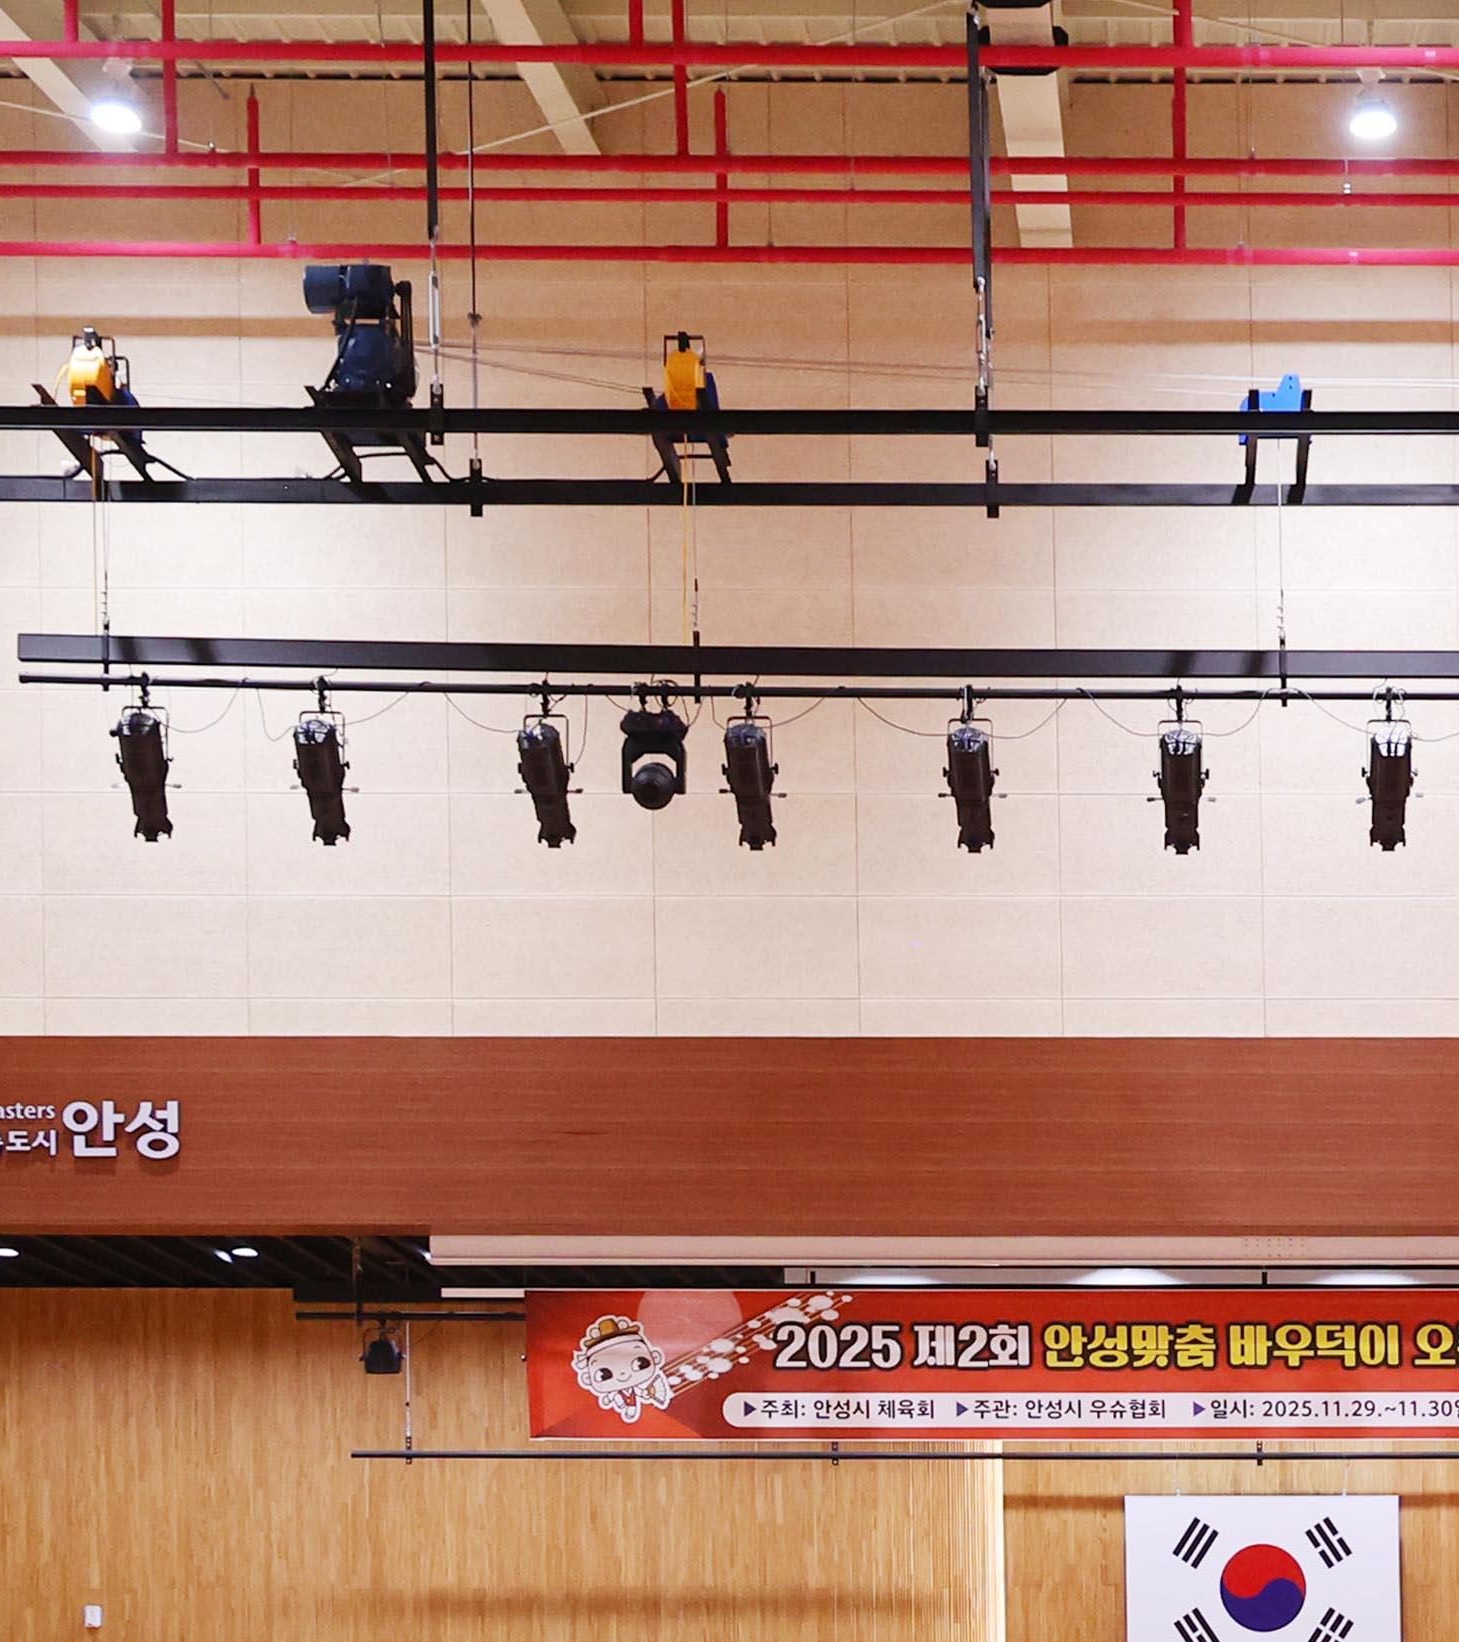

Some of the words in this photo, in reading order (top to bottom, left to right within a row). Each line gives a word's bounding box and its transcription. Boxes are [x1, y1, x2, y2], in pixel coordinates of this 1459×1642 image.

[62, 1100, 180, 1159] 안성
[775, 1324, 902, 1368] 2025
[913, 1324, 1030, 1368] 제2회
[1044, 1324, 1216, 1368] 안성맞춤
[1229, 1324, 1399, 1367] 바우덕이
[761, 1399, 805, 1419] 주최:
[813, 1399, 870, 1420] 안성시
[878, 1399, 934, 1419] 체육회
[973, 1399, 1017, 1419] 주관:
[1025, 1399, 1082, 1420] 안성시
[1089, 1399, 1165, 1419] 우슈협회
[1210, 1399, 1254, 1419] 일시:
